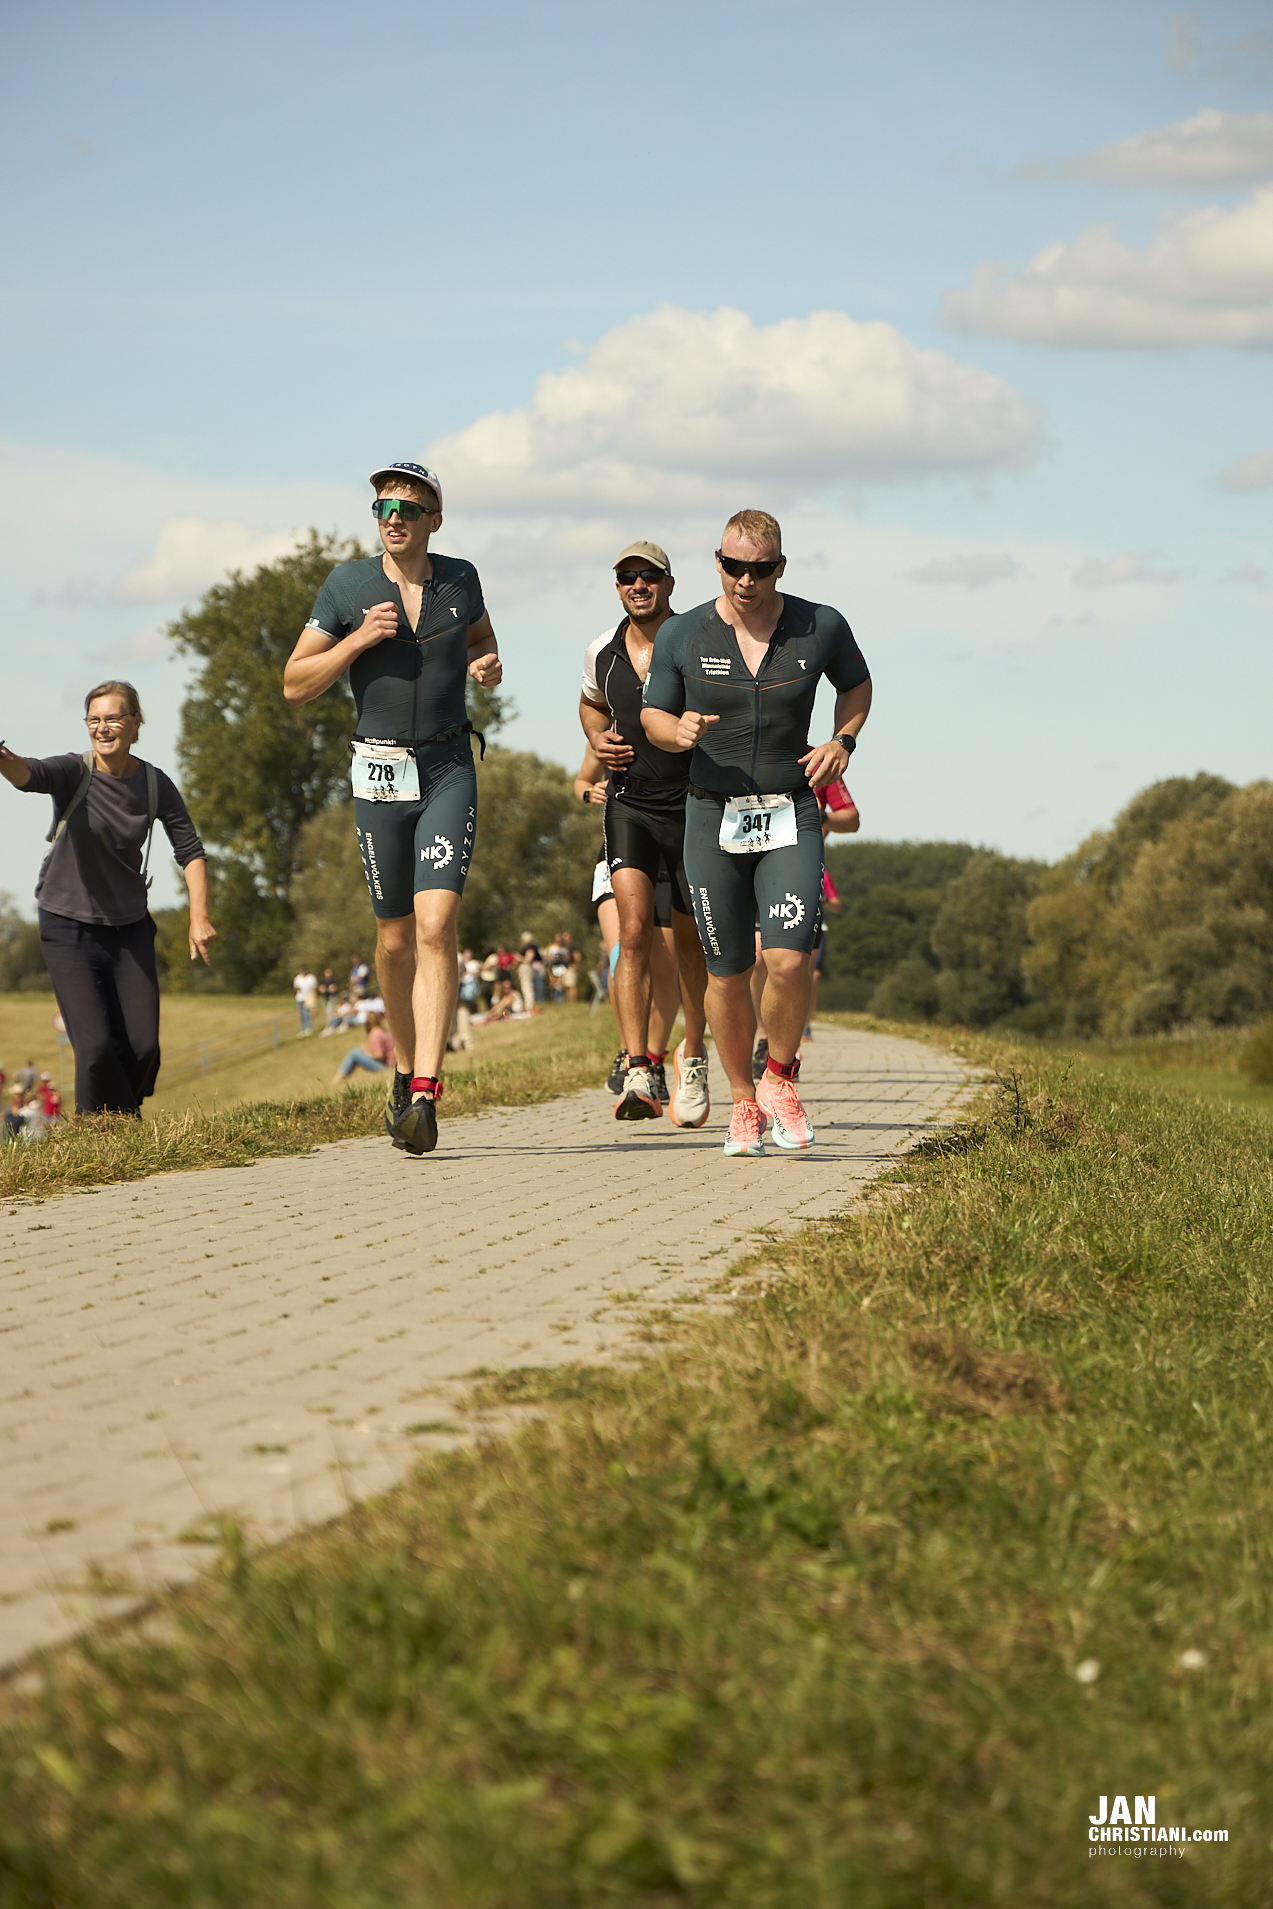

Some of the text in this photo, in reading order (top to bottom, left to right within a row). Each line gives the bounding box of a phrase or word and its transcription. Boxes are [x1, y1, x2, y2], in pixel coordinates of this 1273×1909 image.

[704, 668, 730, 676] Triathlon
[367, 762, 395, 782] 278
[742, 812, 772, 833] 347
[460, 806, 475, 876] RYZON
[420, 845, 444, 861] NK
[768, 903, 795, 919] NK
